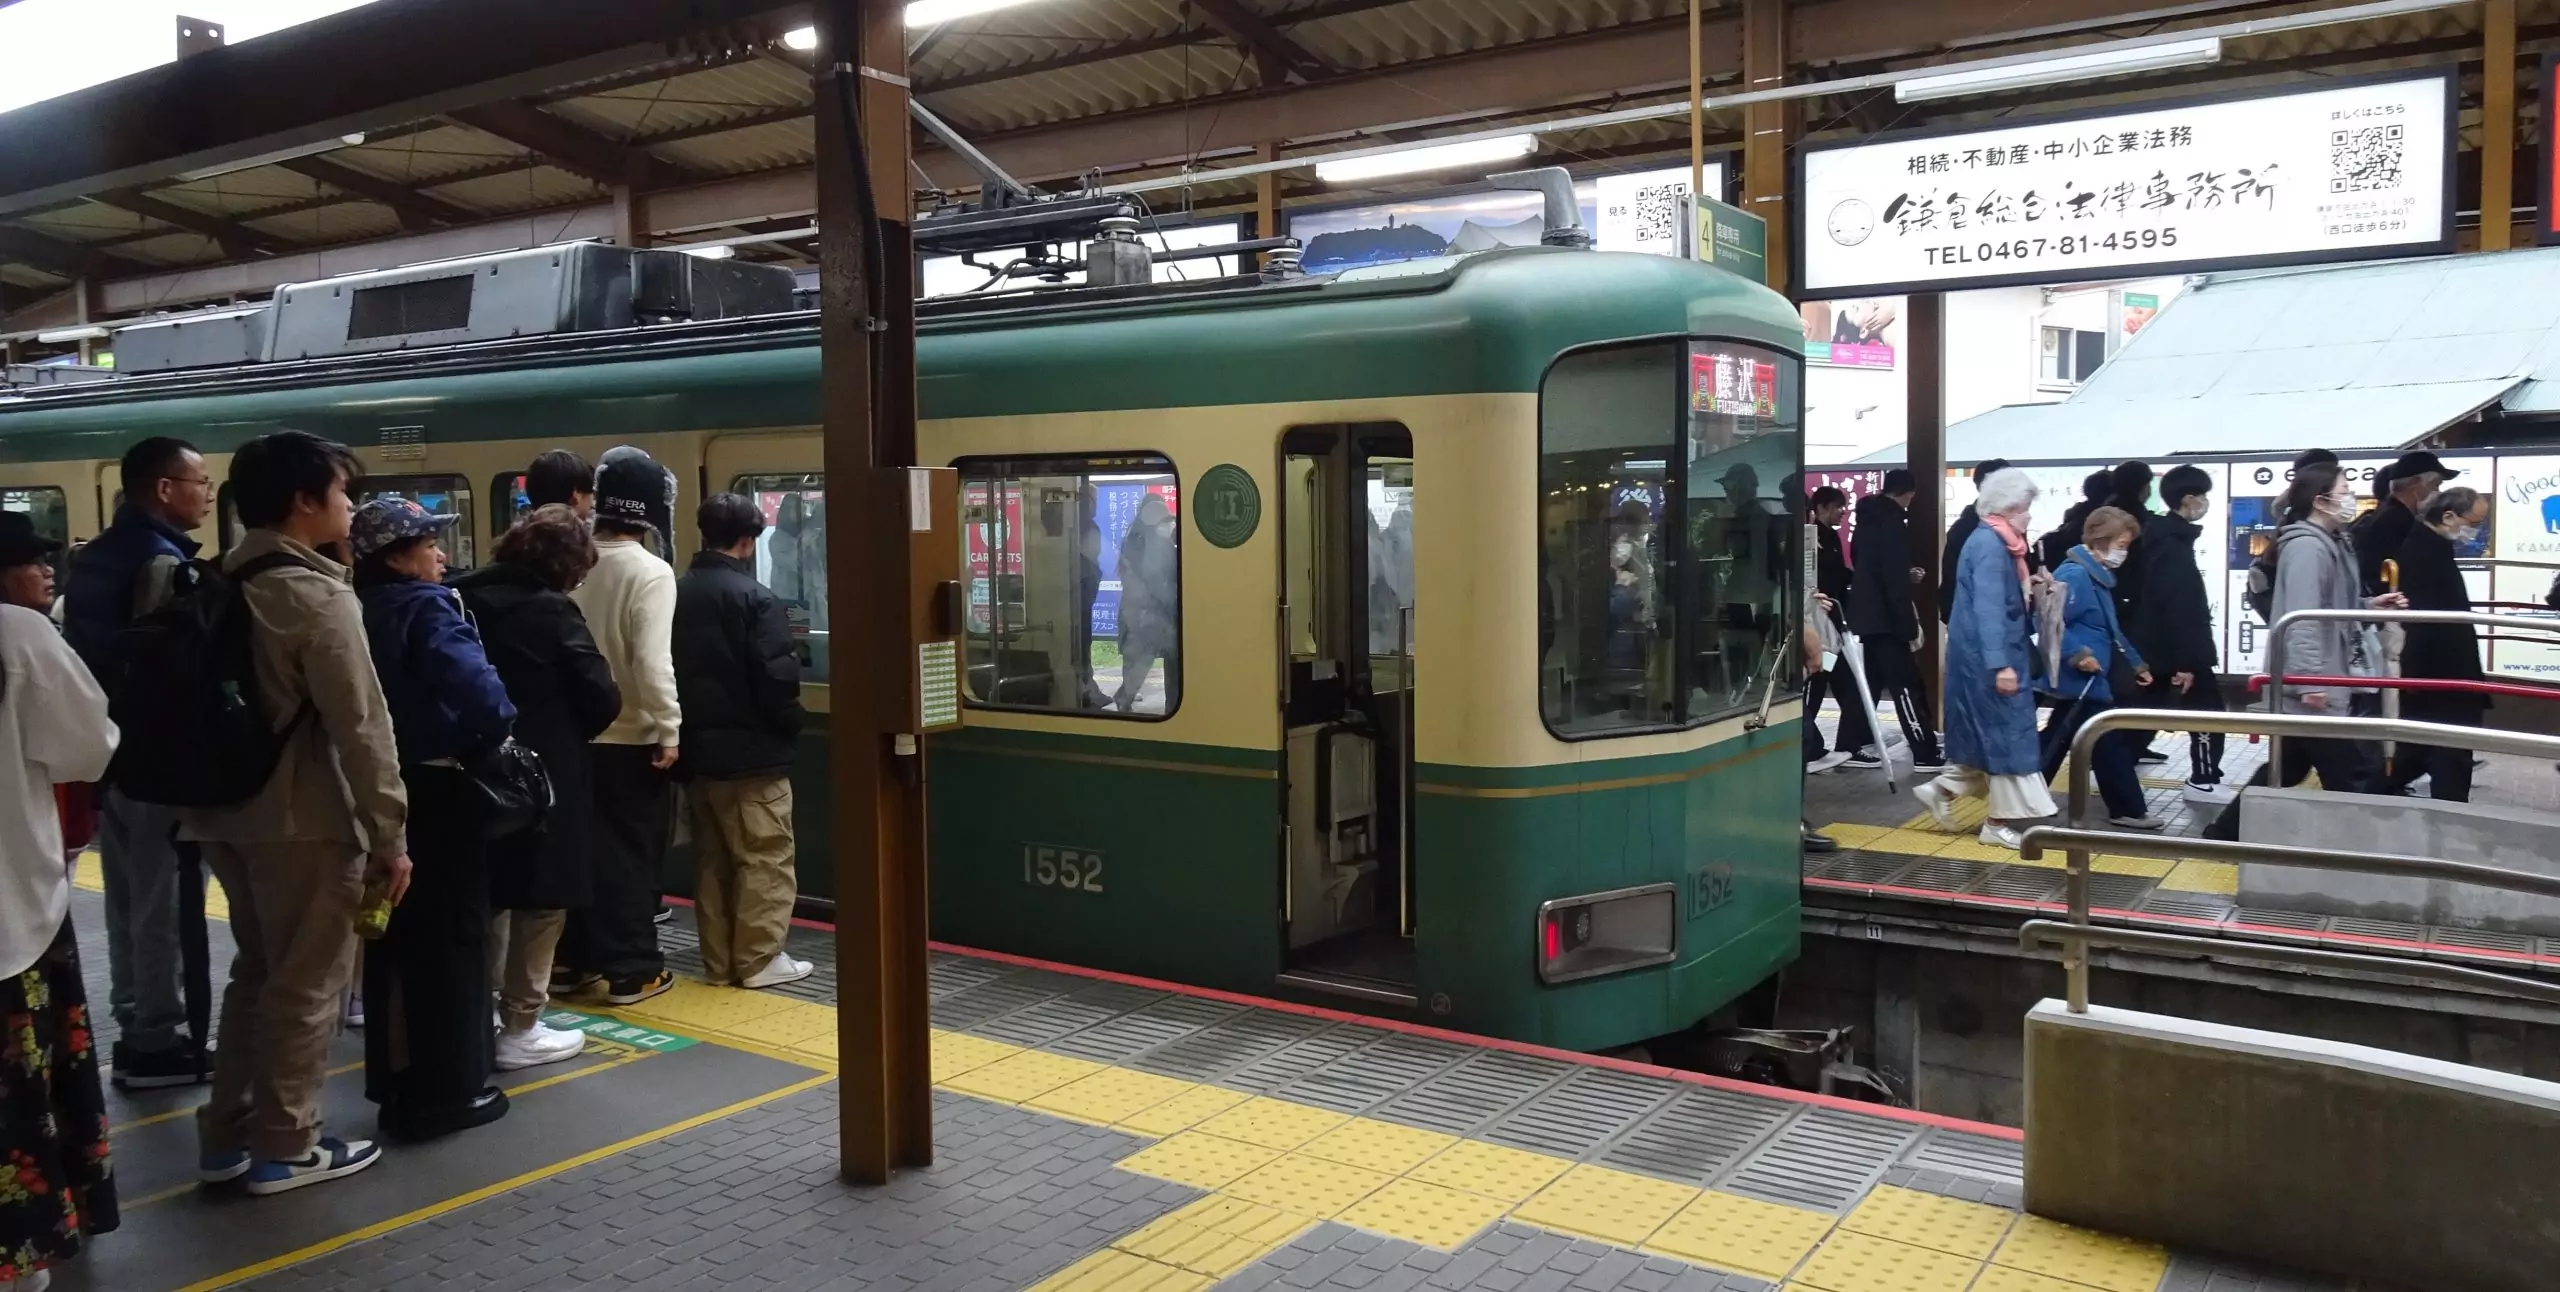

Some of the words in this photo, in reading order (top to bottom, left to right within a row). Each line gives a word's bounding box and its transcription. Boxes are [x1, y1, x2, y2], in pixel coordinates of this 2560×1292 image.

[2331, 104, 2405, 121] 詳しくはこちら
[1701, 219, 1710, 252] 4
[1712, 353, 1755, 402] 藤沢
[1865, 470, 1880, 495] 新鮮
[625, 499, 646, 510] ERA
[1024, 845, 1104, 892] 1552
[1691, 865, 1734, 916] 1552
[1868, 926, 1879, 937] 11
